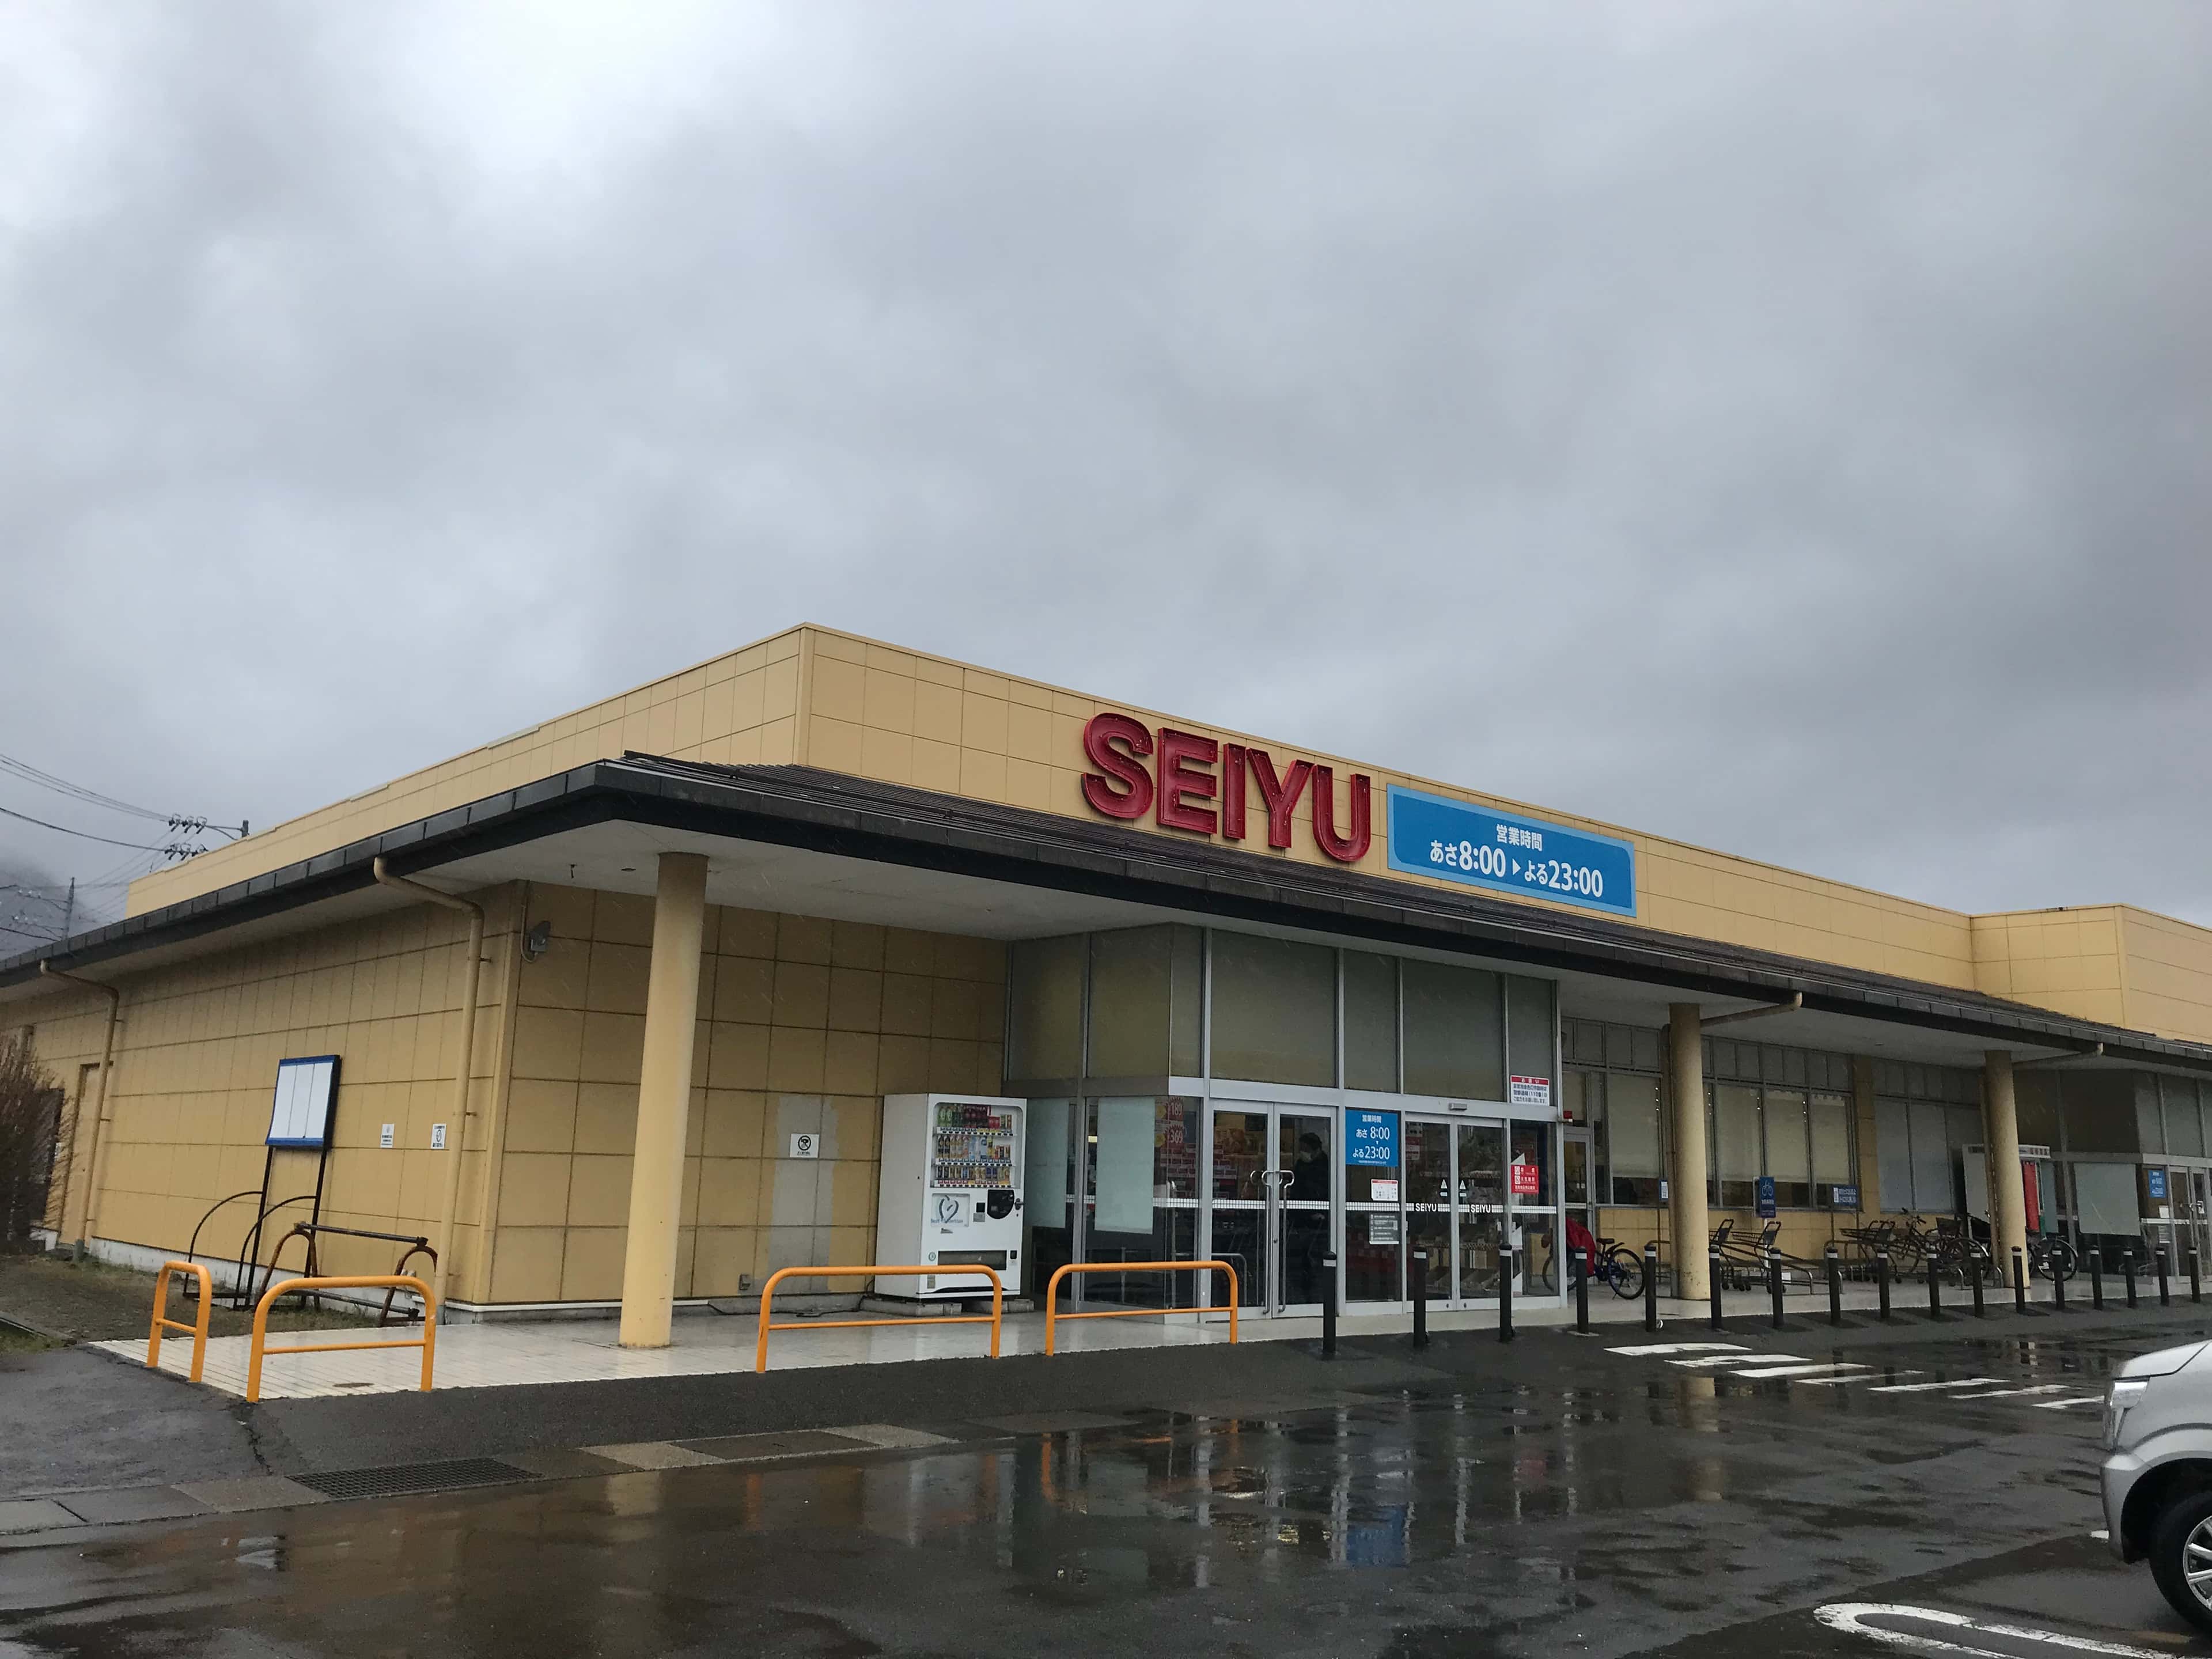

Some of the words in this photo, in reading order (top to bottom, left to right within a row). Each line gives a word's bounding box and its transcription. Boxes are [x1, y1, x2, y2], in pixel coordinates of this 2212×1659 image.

[1081, 712, 1371, 862] SEIYU
[1496, 824, 1543, 851] 営業時間
[1415, 1202, 1437, 1212] SEIYU
[1470, 1204, 1491, 1213] SEIYU
